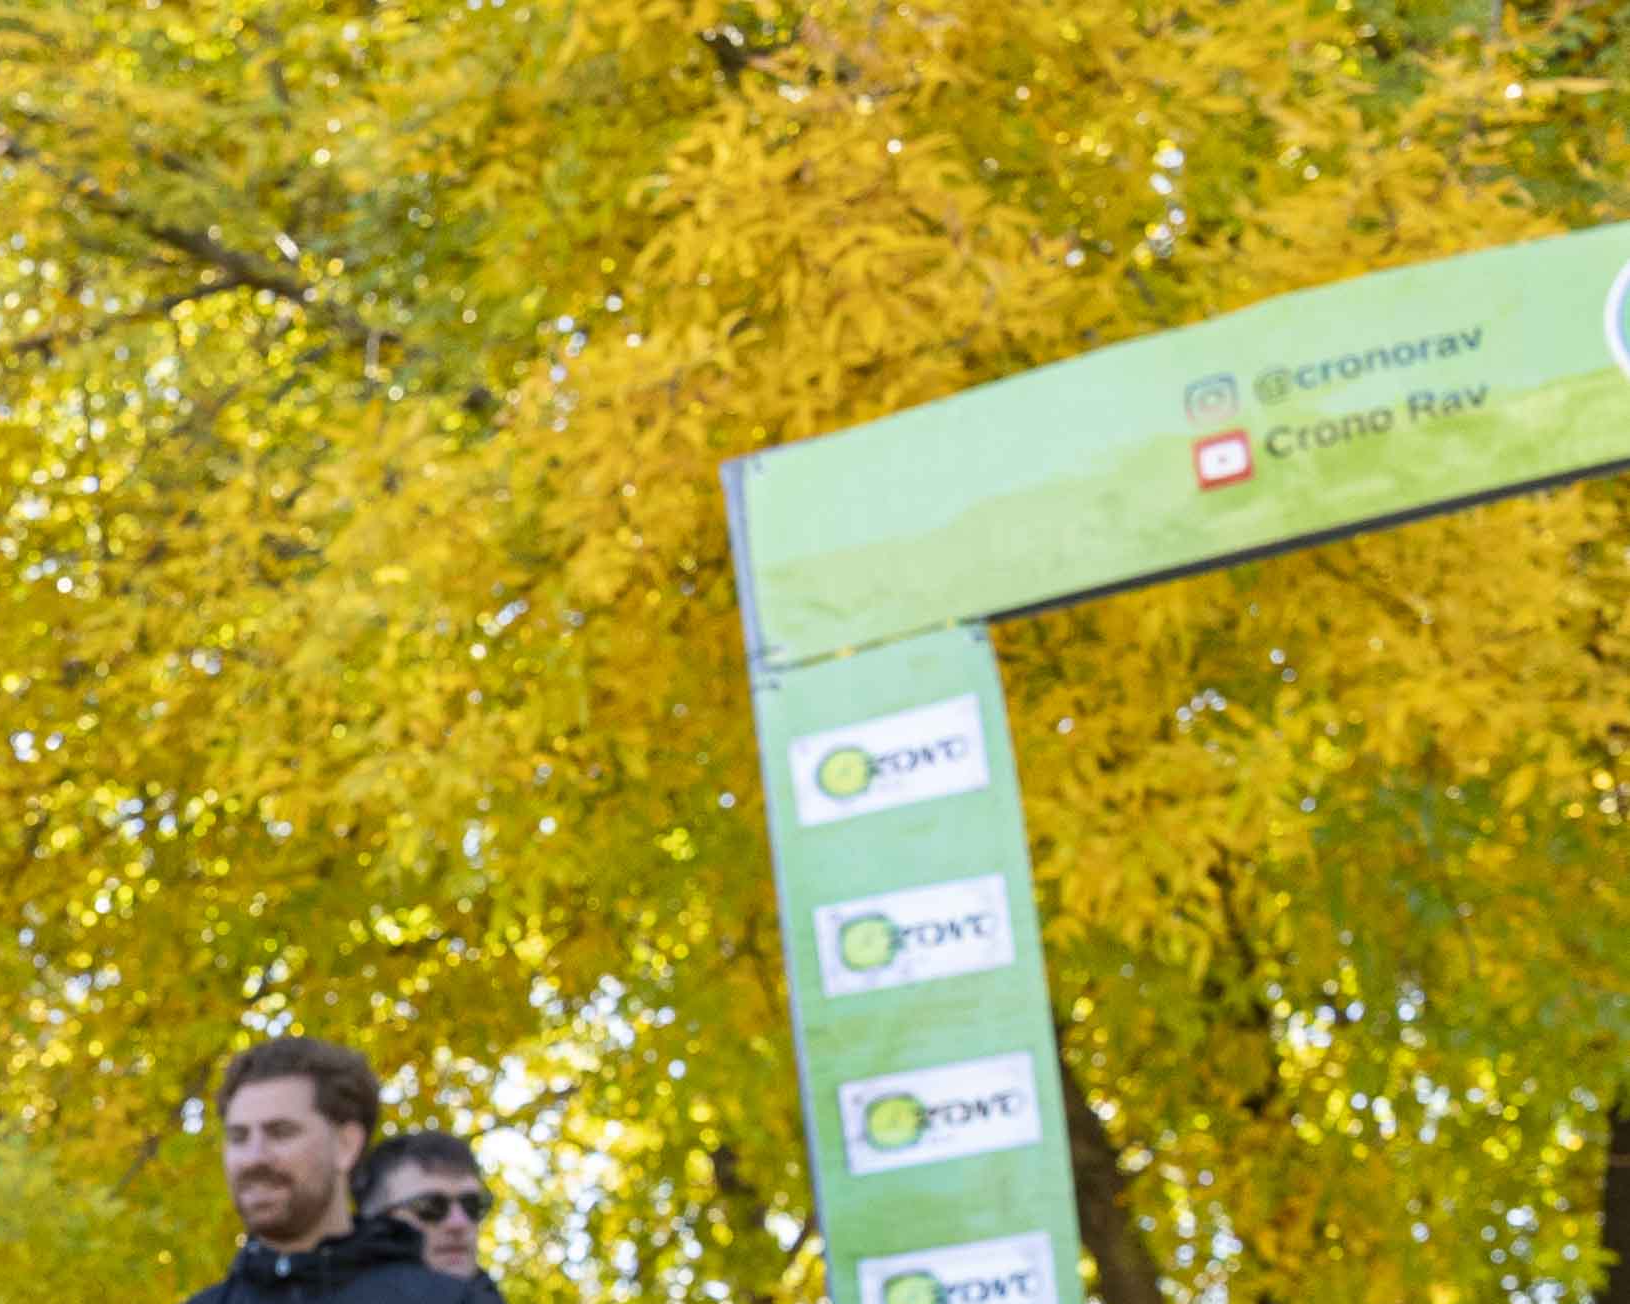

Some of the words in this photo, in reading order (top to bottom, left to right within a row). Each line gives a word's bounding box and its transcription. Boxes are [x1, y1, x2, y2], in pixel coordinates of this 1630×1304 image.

[1254, 327, 1482, 405] @cronorav
[1265, 407, 1392, 458] Crono
[1405, 384, 1489, 422] Rav
